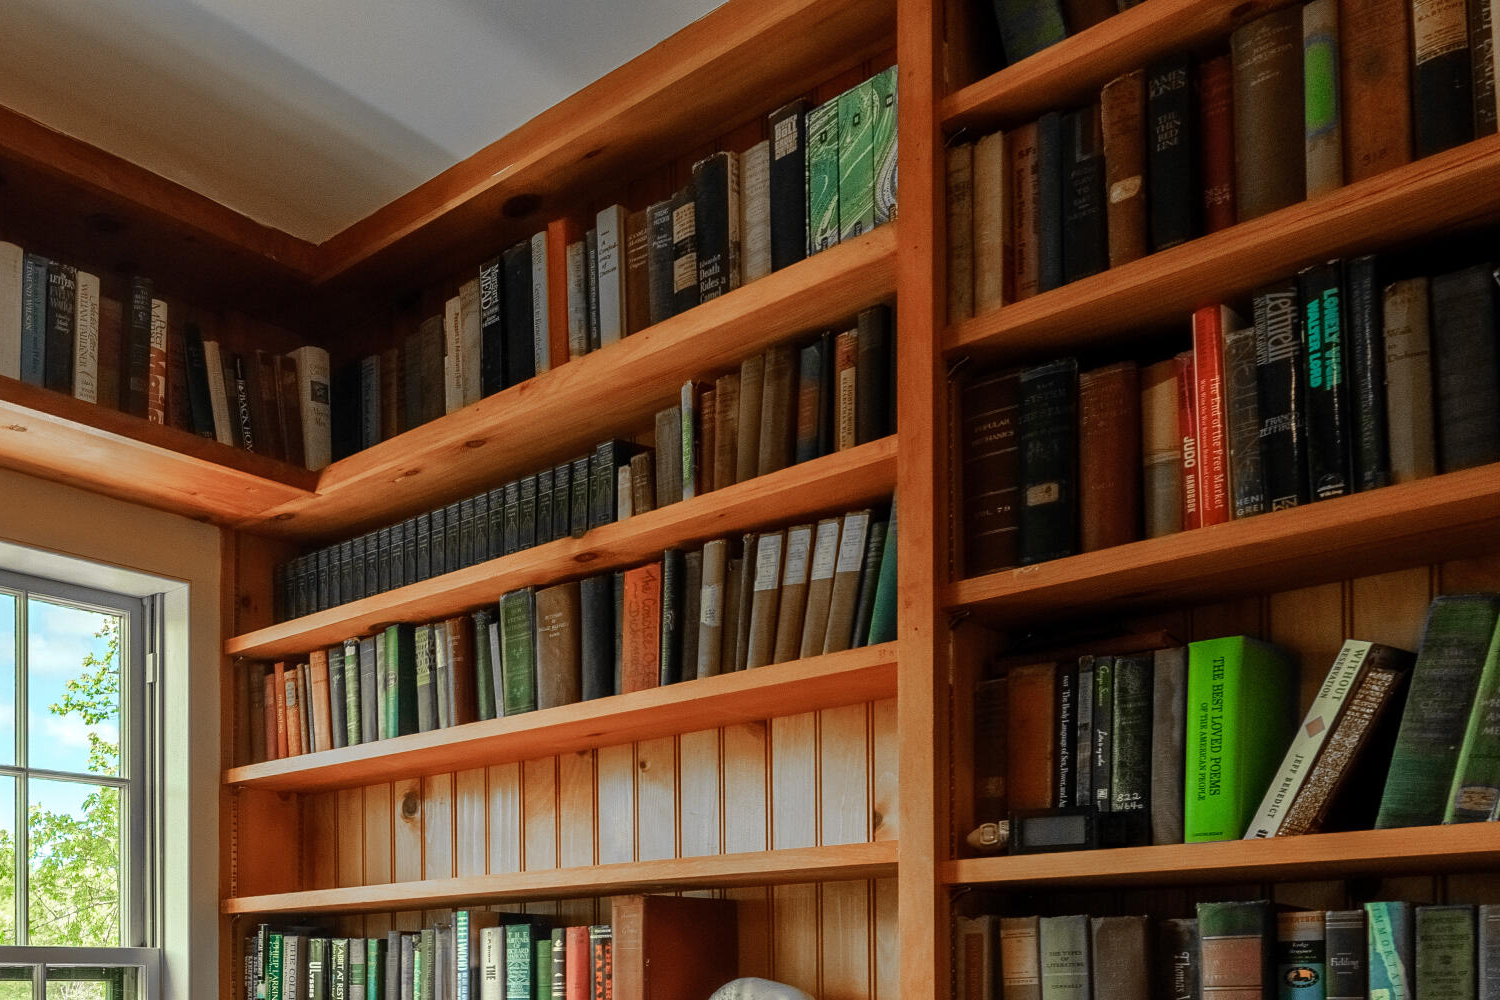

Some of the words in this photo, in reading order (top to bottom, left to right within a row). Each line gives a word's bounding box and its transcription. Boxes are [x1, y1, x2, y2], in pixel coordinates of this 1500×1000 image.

[492, 264, 500, 304] Margaret
[700, 264, 720, 281] Death
[700, 278, 720, 292] Rides
[482, 268, 490, 310] MEAD
[25, 298, 33, 330] WILSON
[1306, 299, 1320, 352] WALTER
[1323, 287, 1339, 343] LONELY
[1308, 353, 1321, 387] LORD
[1209, 375, 1219, 393] The
[1210, 396, 1220, 418] End
[1211, 420, 1220, 430] of
[1211, 432, 1221, 445] the
[1183, 436, 1194, 467] JUDO
[1212, 450, 1222, 469] Free
[1184, 474, 1196, 513] HANDBOOK
[1213, 473, 1223, 507] Market
[1211, 656, 1224, 680] THE
[1319, 646, 1350, 700] RESERVATION
[1331, 645, 1365, 702] WITHOUT
[1062, 690, 1070, 702] The
[1199, 702, 1207, 711] OF
[1210, 684, 1223, 711] BEST
[1061, 719, 1069, 747] Language
[1199, 714, 1207, 729] THE
[1209, 715, 1223, 753] LOVED
[1198, 731, 1206, 770] AMERICAN
[1287, 753, 1304, 775] JEFF
[1197, 774, 1205, 800] PEOPLE
[1208, 757, 1222, 795] POEMS
[1266, 776, 1293, 819] BENEDICT
[271, 941, 279, 968] PHILIP
[336, 943, 344, 969] RABBIT
[1330, 957, 1360, 970] Fielding
[308, 962, 322, 998] ULYSSES
[336, 970, 343, 980] AT
[485, 965, 495, 980] THE
[1174, 951, 1190, 991] Thomas
[335, 983, 343, 1000] REST
